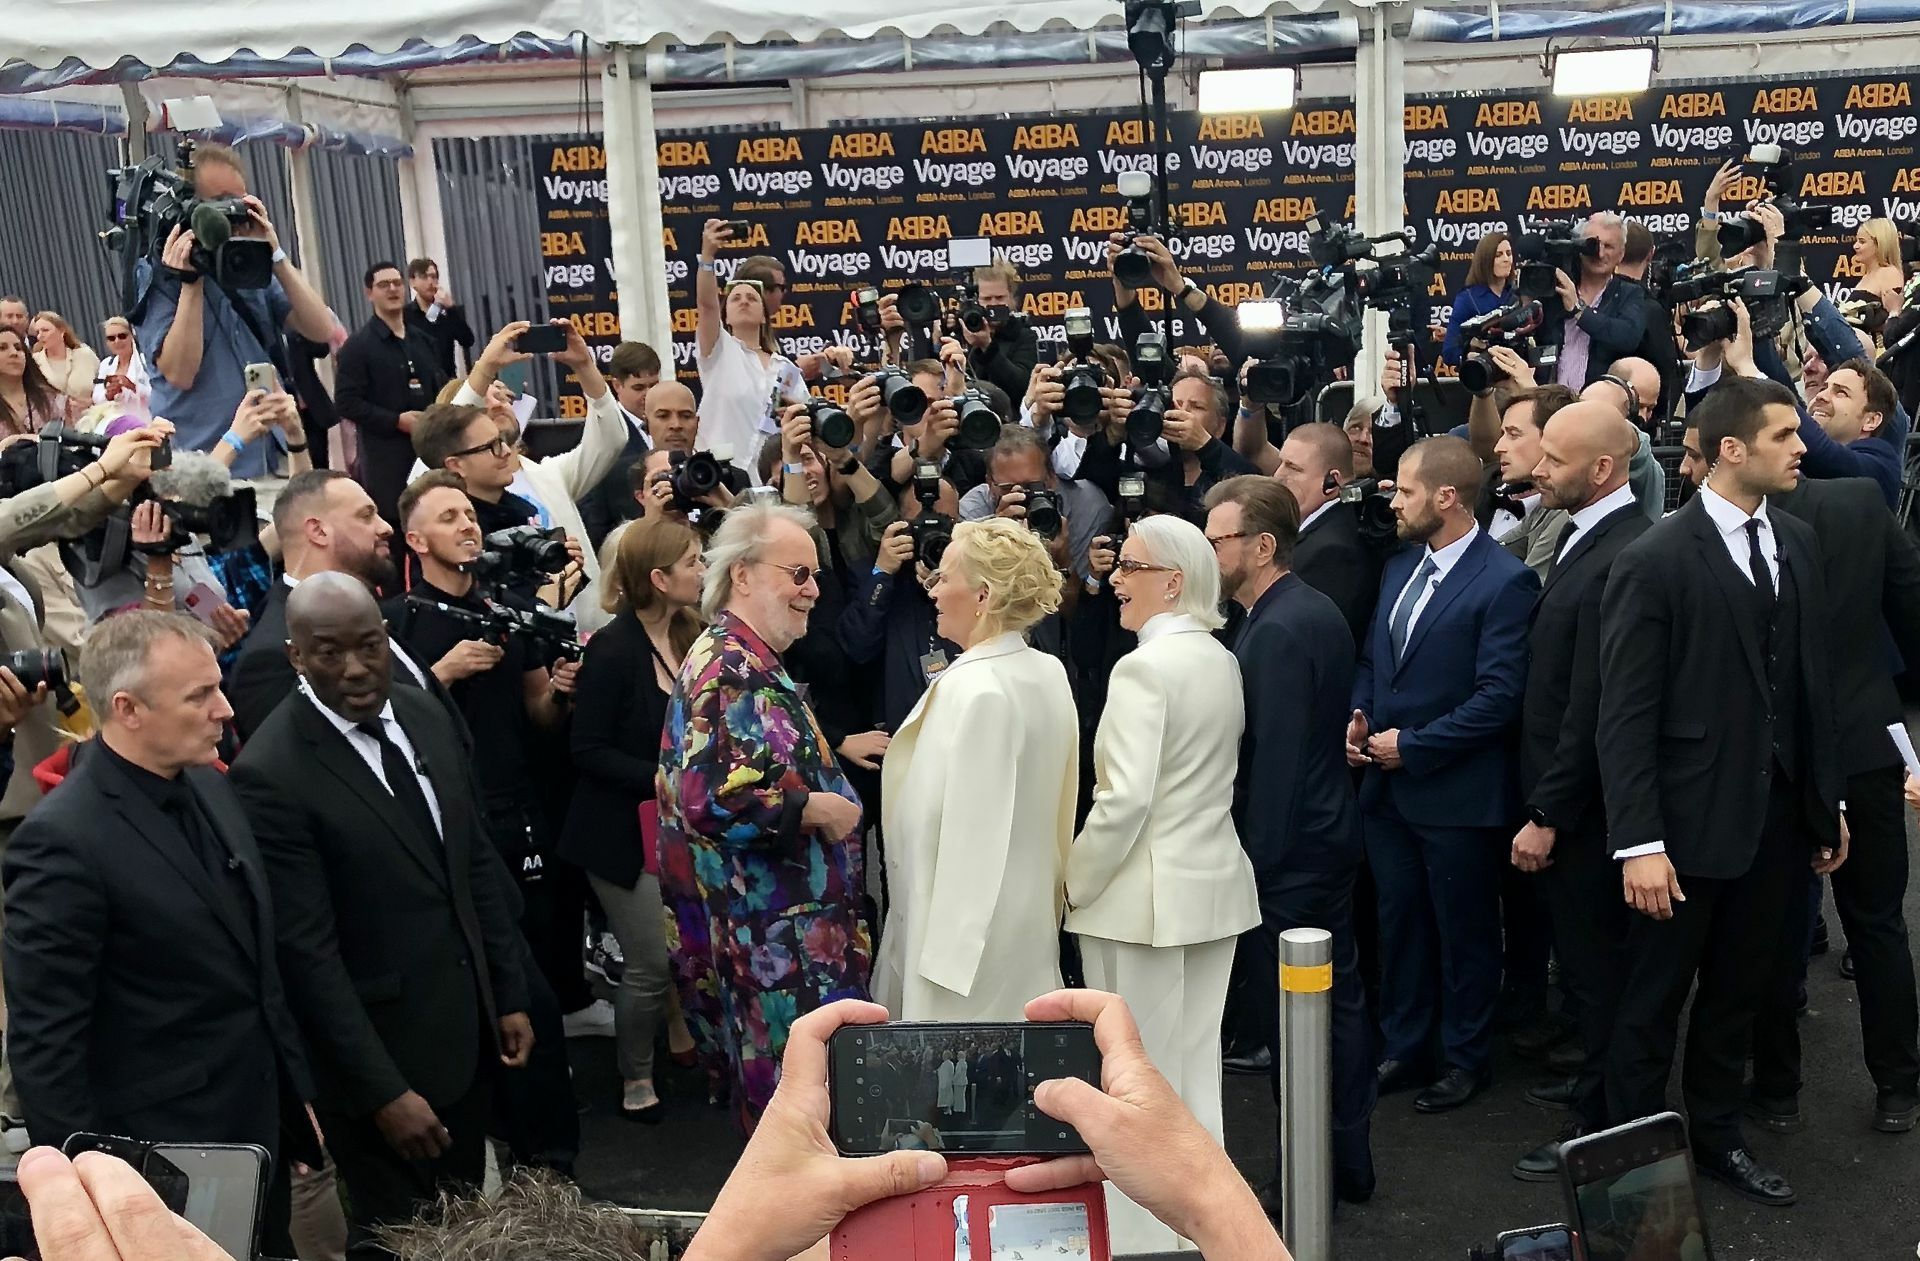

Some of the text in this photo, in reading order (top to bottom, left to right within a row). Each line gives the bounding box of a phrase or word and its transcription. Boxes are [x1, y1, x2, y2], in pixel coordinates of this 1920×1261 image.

[1660, 92, 1726, 118] ABBA
[1752, 86, 1818, 114] ABBA
[1844, 82, 1912, 109] ABBA
[1290, 110, 1356, 136] ABBA
[1404, 104, 1448, 130] BBA
[1476, 101, 1542, 128] ABBA
[1568, 97, 1634, 123] ABBA
[1013, 124, 1080, 150] ABBA
[1198, 114, 1264, 140] ABBA
[1651, 123, 1733, 152] Voyage
[1743, 118, 1824, 145] Voyage
[1835, 114, 1918, 142] Voyage
[658, 141, 711, 167] BBA
[736, 137, 802, 164] ABBA
[828, 133, 894, 159] ABBA
[920, 128, 987, 154] ABBA
[1403, 138, 1456, 164] yage
[1466, 132, 1549, 160] Voyage
[1559, 127, 1641, 156] Voyage
[1834, 146, 1914, 158] ABBA Arena, London
[1097, 150, 1180, 176] Voyae
[1190, 146, 1272, 174] Voyage
[1559, 160, 1638, 172] ABBA Arena, London
[1650, 156, 1722, 168] ABBA Arena, Lond
[1794, 150, 1820, 160] London
[821, 163, 904, 192] Voyage
[913, 158, 996, 186] Voyage
[1005, 154, 1088, 183] Voyage
[1284, 172, 1354, 184] ABBA Arena, Lond
[1404, 168, 1454, 180] rena, London
[1468, 164, 1546, 176] ABBA Arena, London
[1892, 168, 1920, 192] AB
[543, 176, 608, 204] Voyag
[657, 172, 720, 200] oyage
[728, 167, 812, 198] Voyage
[1008, 186, 1088, 198] ABBA Arena, London
[1192, 176, 1271, 188] ABBA Arena, London
[1618, 180, 1682, 206] ABBA
[1800, 170, 1866, 196] ABBA
[732, 200, 812, 211] ABBA Arena, London
[825, 196, 904, 207] ABBA Arena, London
[916, 190, 996, 202] ABBA Arena, London
[1435, 188, 1500, 214] ABBA
[1526, 184, 1592, 210] ABBA
[1882, 196, 1920, 222] Voy
[1253, 196, 1316, 223] ABBA
[796, 219, 862, 246] ABBA
[887, 215, 952, 240] ABBA
[978, 210, 1044, 237] ABBA
[541, 231, 586, 256] BBA
[1062, 236, 1112, 265] Voya
[1168, 234, 1236, 260] oyage
[1244, 227, 1310, 256] Voyag
[1811, 234, 1838, 245] Arena,
[788, 249, 871, 278] Voyage
[878, 244, 949, 274] Voyag
[1206, 262, 1234, 272] London
[1246, 261, 1268, 271] ABBA
[1268, 260, 1296, 270] Arena,
[1832, 254, 1866, 278] AB
[792, 282, 812, 293] ABBA
[813, 282, 840, 292] Arena,
[1025, 272, 1053, 282] London
[1064, 270, 1087, 280] ABBA
[1022, 290, 1084, 316] ABBA
